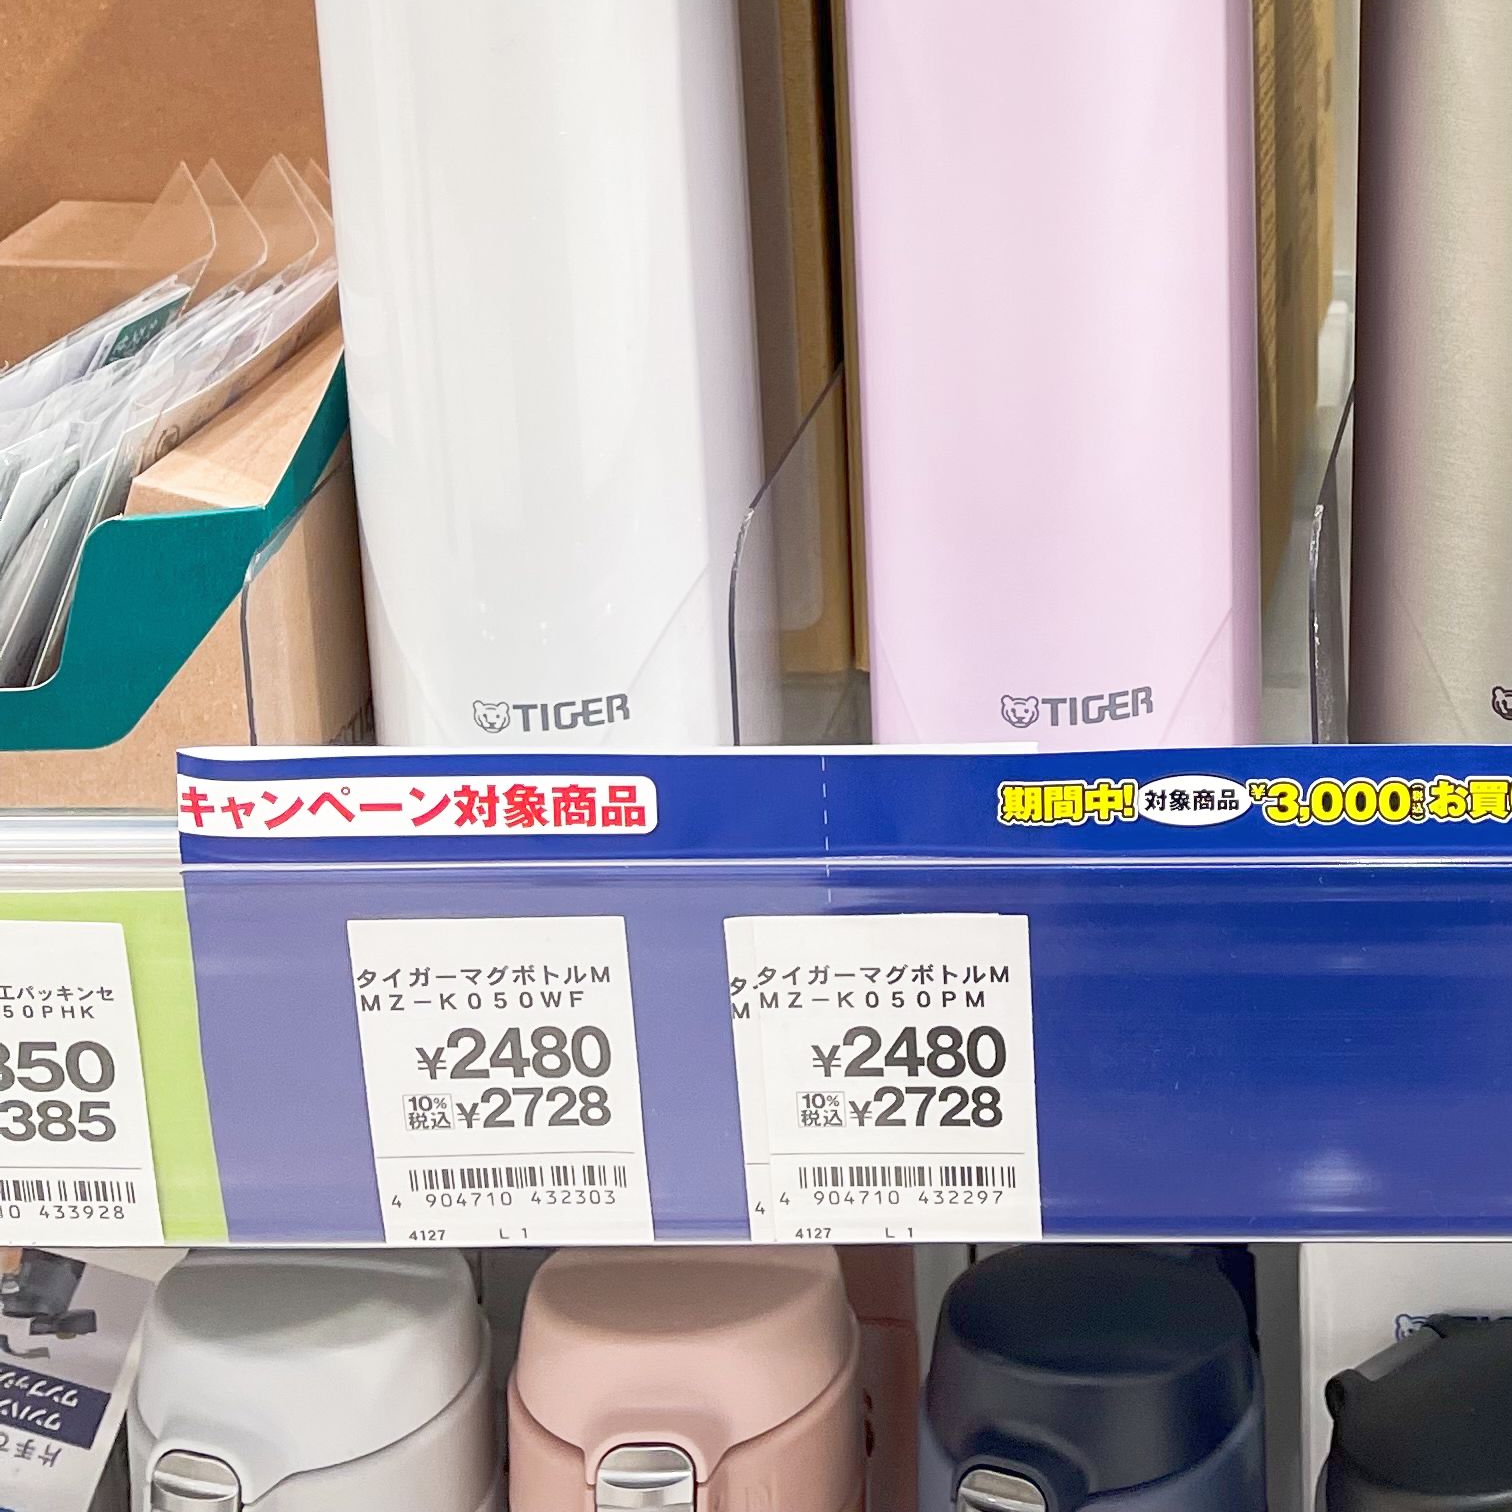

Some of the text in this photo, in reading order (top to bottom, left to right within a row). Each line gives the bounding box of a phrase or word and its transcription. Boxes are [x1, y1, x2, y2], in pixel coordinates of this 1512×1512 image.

[512, 693, 630, 733] TIGER
[1041, 686, 1153, 729] TIGER
[181, 783, 646, 830] キャンペーン対象商品
[1001, 780, 1137, 824] 期間中!
[1144, 790, 1240, 813] 対象商品
[356, 965, 611, 989] タイガーマグボトルM
[757, 965, 1009, 986] タイガーマグボトルM
[416, 1025, 611, 1080] ¥2480
[811, 1025, 1006, 1078] ¥2480
[408, 1095, 447, 1111] 10%
[456, 1085, 611, 1129] ¥2728
[802, 1093, 840, 1109] 10%
[849, 1085, 1002, 1128] ¥2728
[408, 1112, 451, 1130] 税込
[801, 1109, 843, 1127] 税込
[391, 1190, 616, 1208] 4 904710 432303
[780, 1190, 1003, 1205] 4 904710 432297
[39, 1205, 125, 1220] 433928
[409, 1229, 446, 1241] 4127
[795, 1228, 831, 1239] 4127
